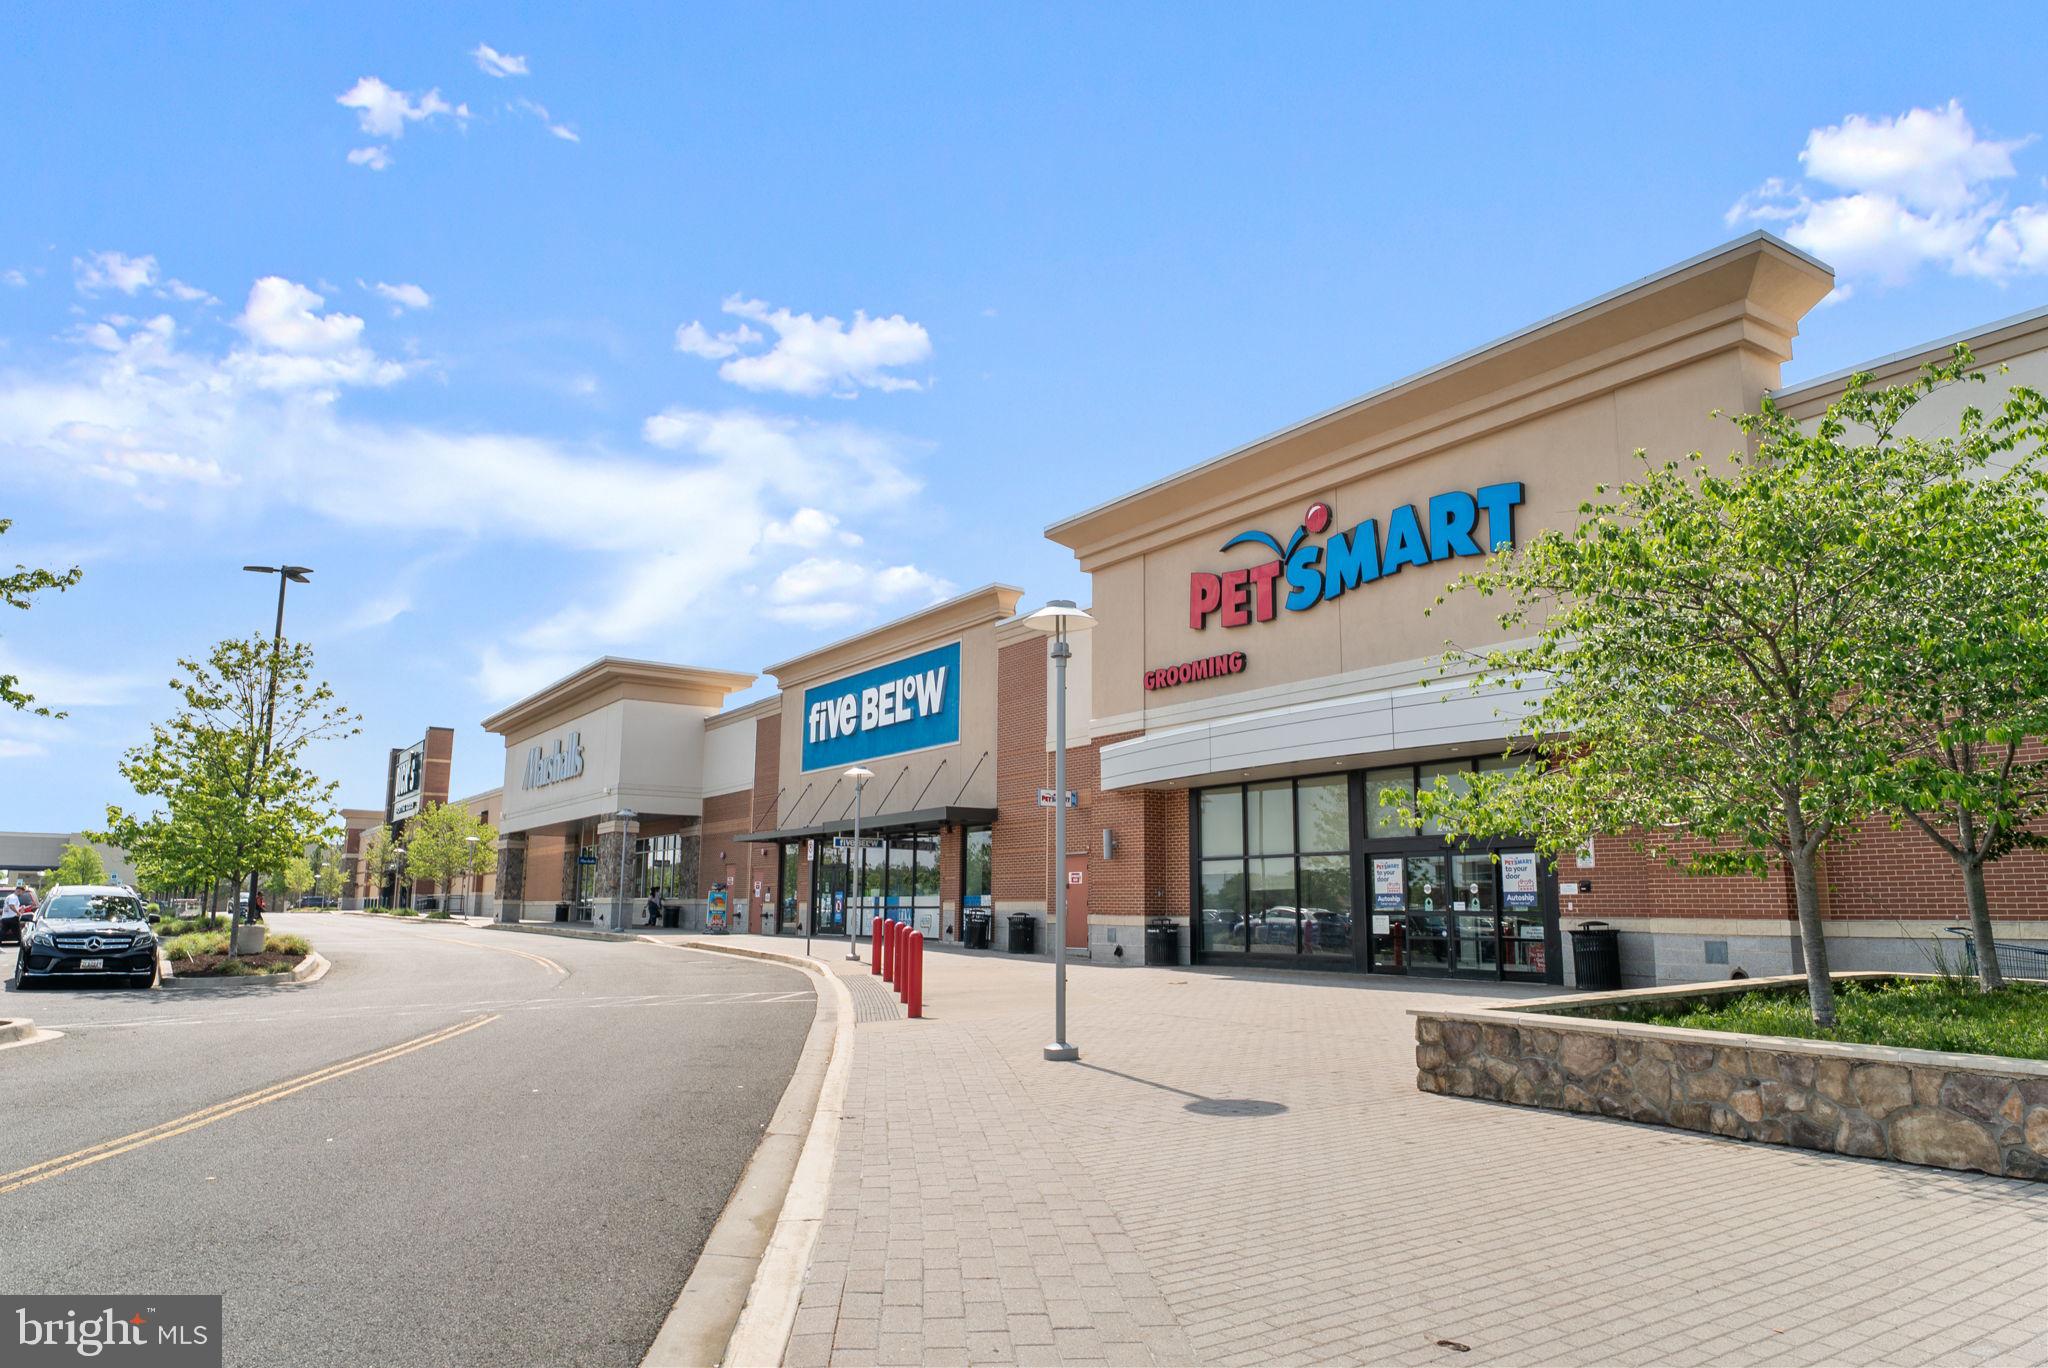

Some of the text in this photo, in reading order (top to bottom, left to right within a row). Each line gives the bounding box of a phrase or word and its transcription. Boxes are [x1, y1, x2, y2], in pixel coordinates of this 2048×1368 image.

[1190, 482, 1525, 631] PETSMART
[1144, 651, 1246, 690] GROOMING
[522, 731, 585, 791] Marshalls
[1506, 893, 1535, 903] Autoship
